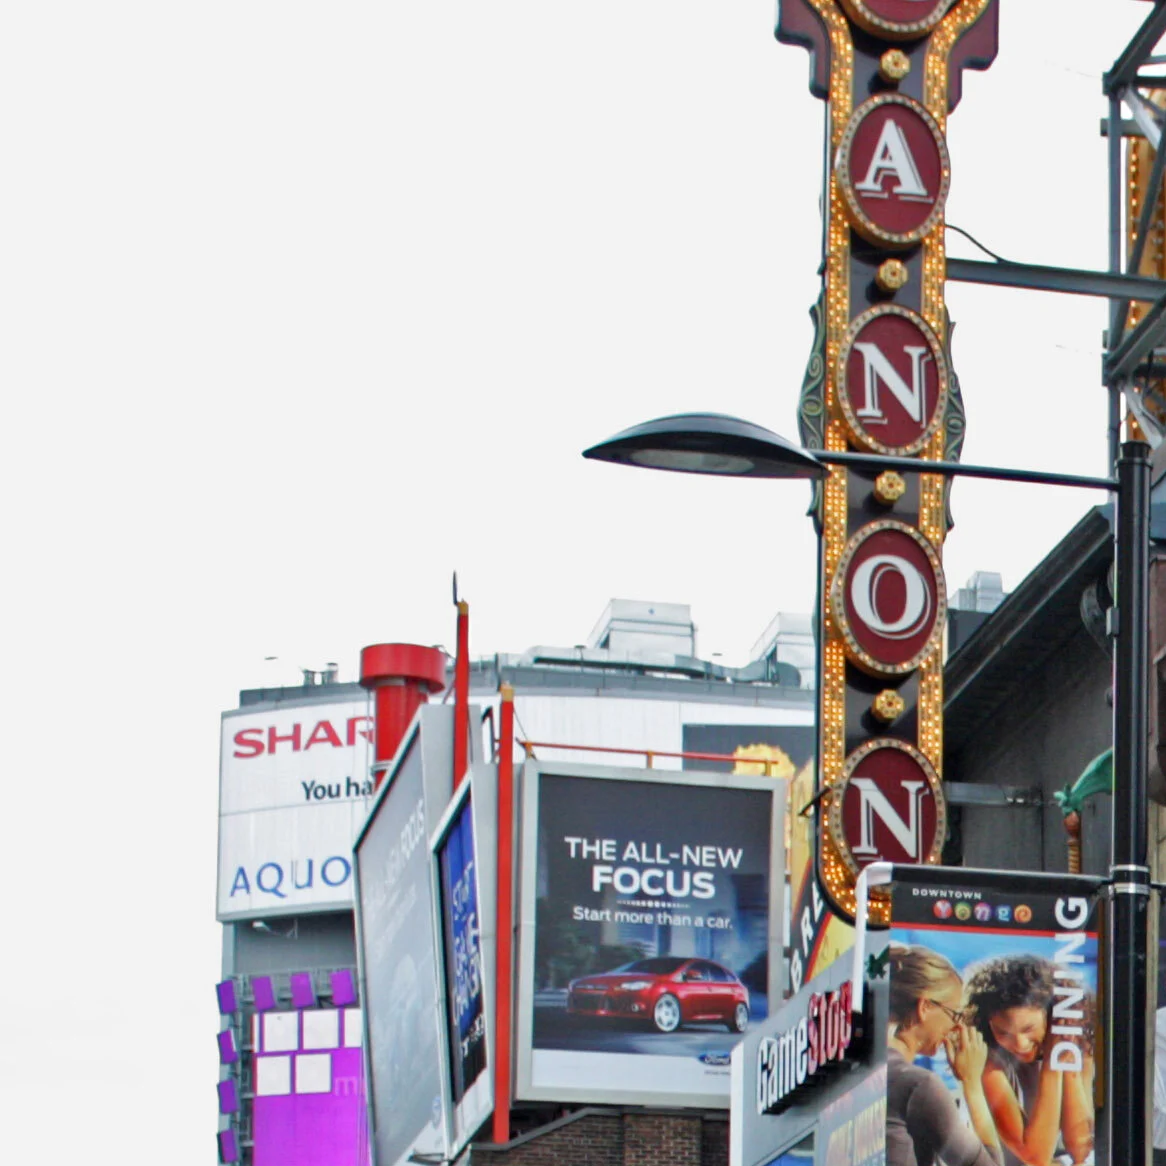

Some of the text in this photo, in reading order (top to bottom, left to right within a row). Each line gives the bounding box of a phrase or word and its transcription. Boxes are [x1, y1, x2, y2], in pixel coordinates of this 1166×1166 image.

[302, 780, 341, 801] You
[564, 836, 744, 869] THE ALL-NEW
[229, 856, 352, 899] AQUO
[592, 865, 716, 899] FOCUS
[912, 888, 982, 900] DOWNTOWN
[573, 906, 734, 930] Start more than a car.
[1050, 897, 1089, 1073] DINING
